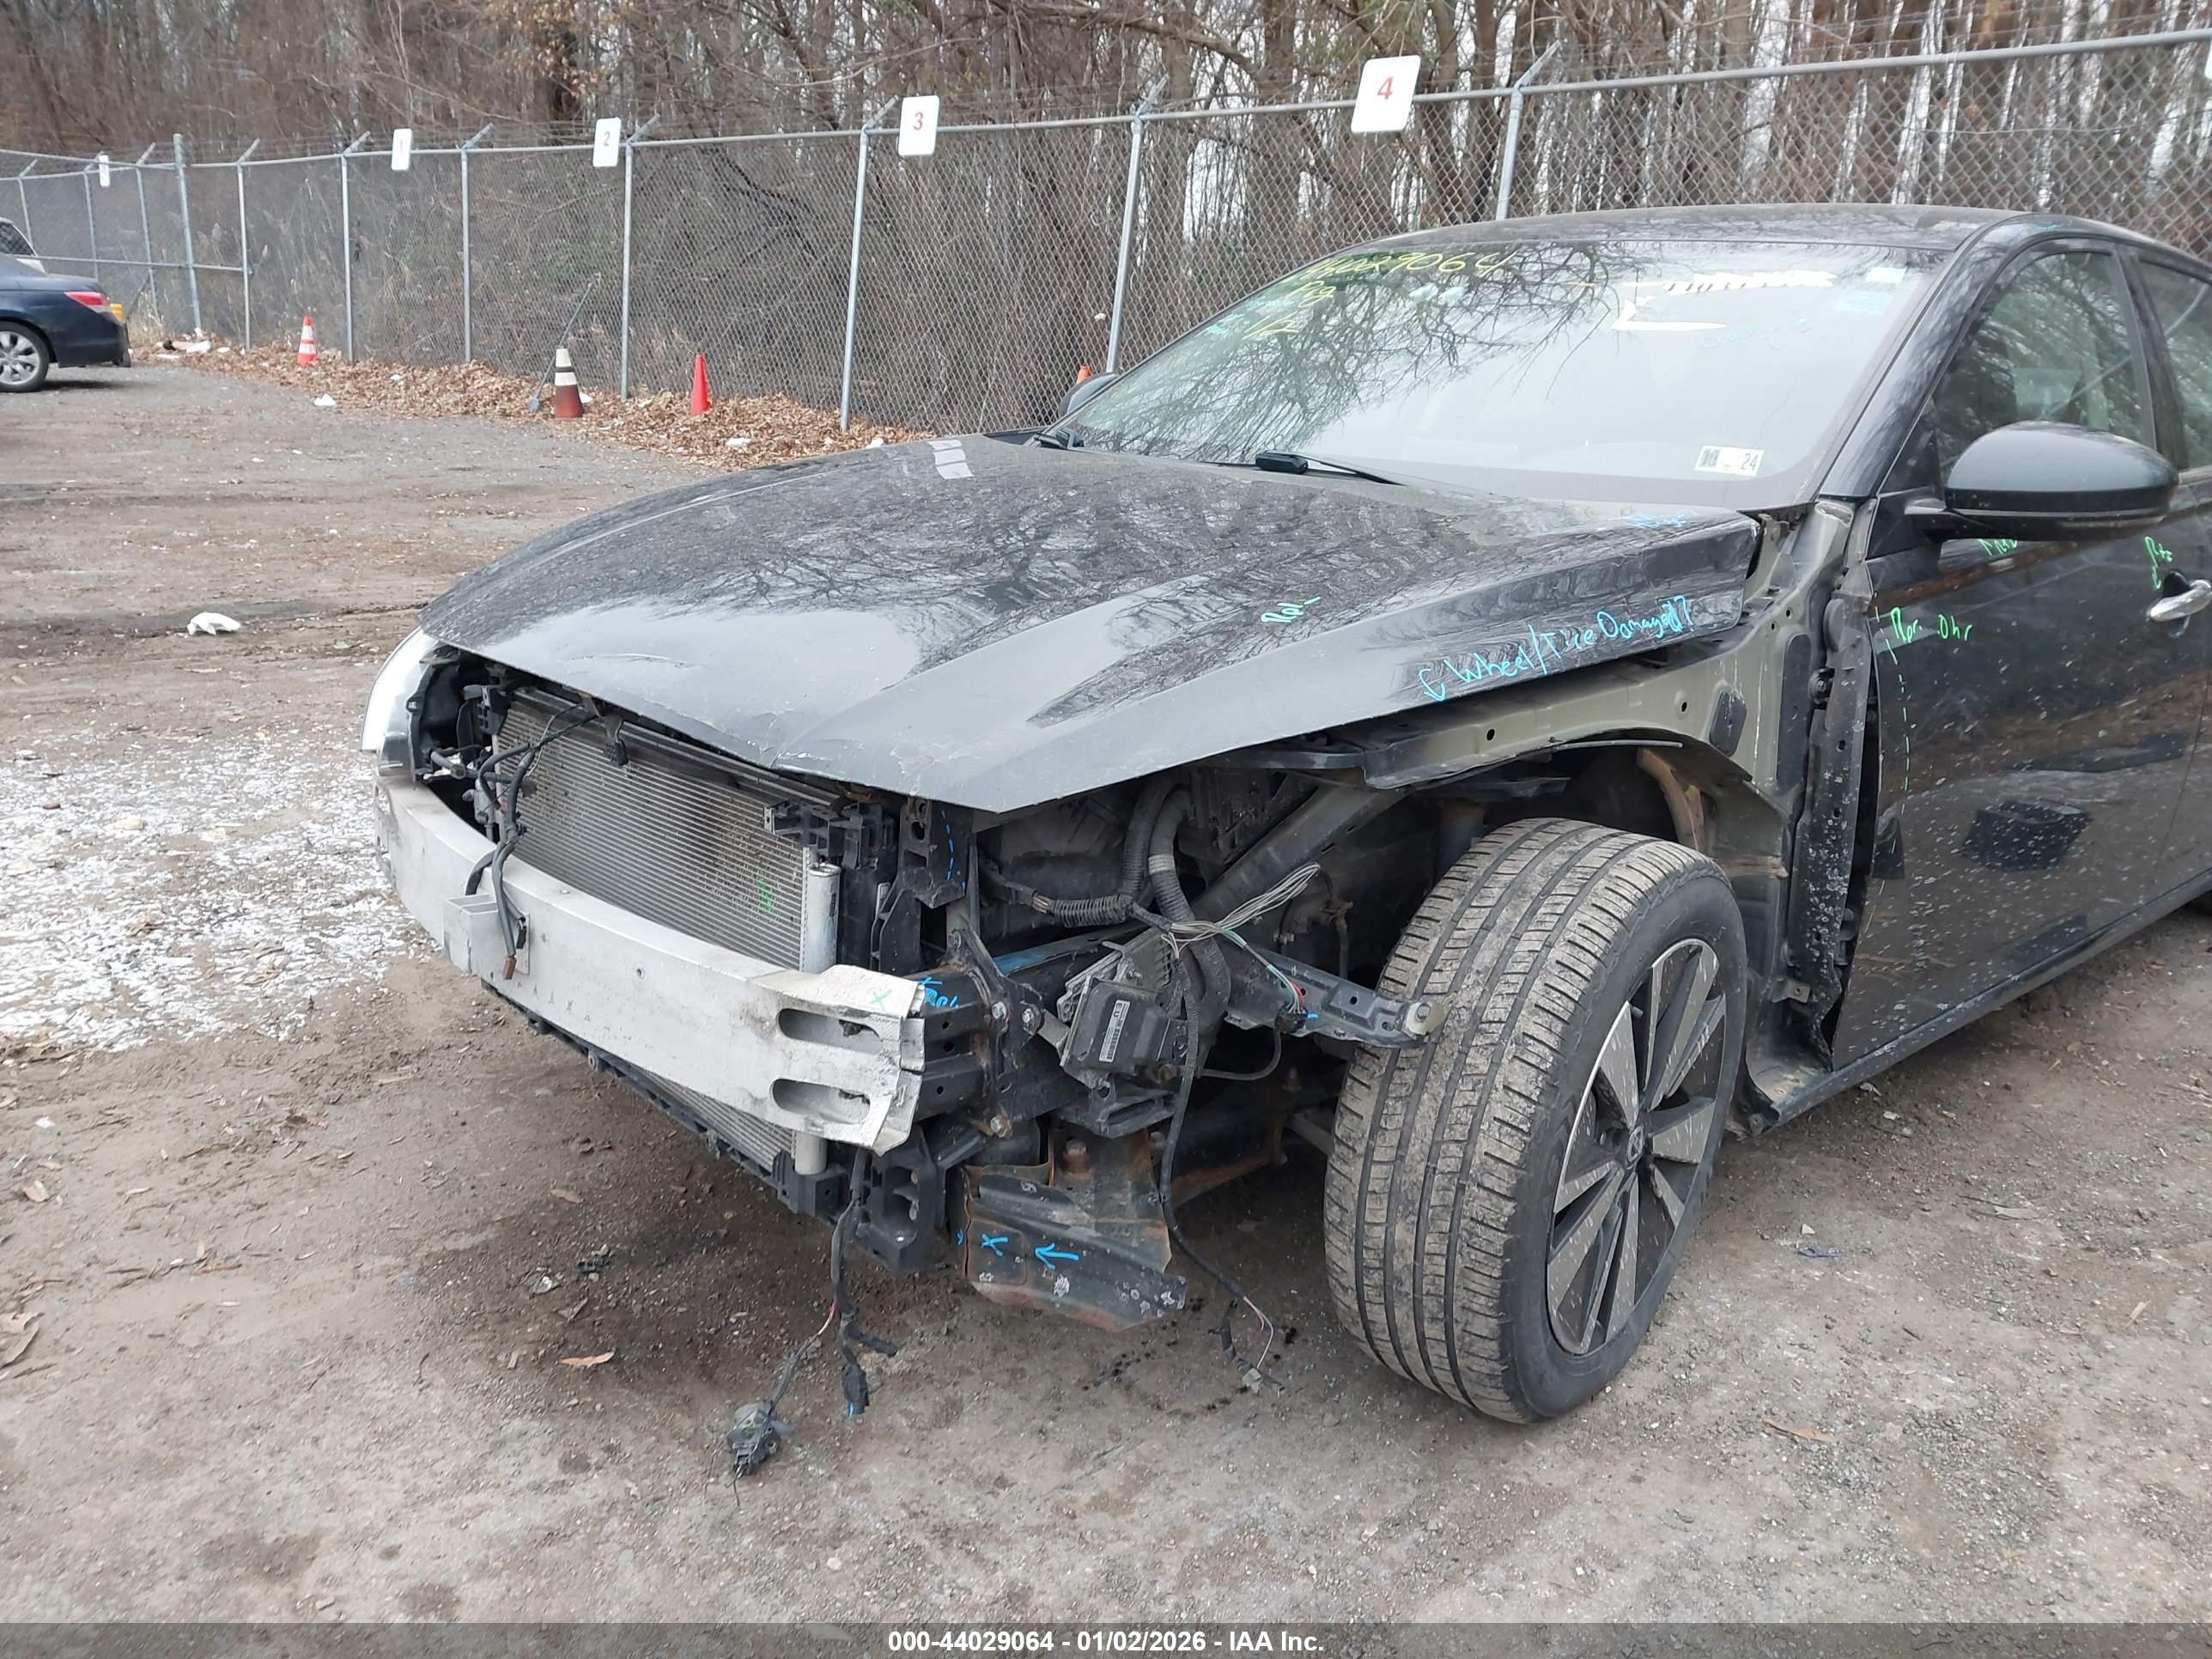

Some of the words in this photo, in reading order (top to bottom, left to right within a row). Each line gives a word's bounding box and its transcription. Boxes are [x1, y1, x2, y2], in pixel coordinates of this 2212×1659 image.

[1377, 76, 1393, 100] 4
[914, 111, 924, 131] 3
[604, 131, 611, 147] 2
[1740, 453, 1759, 471] 24
